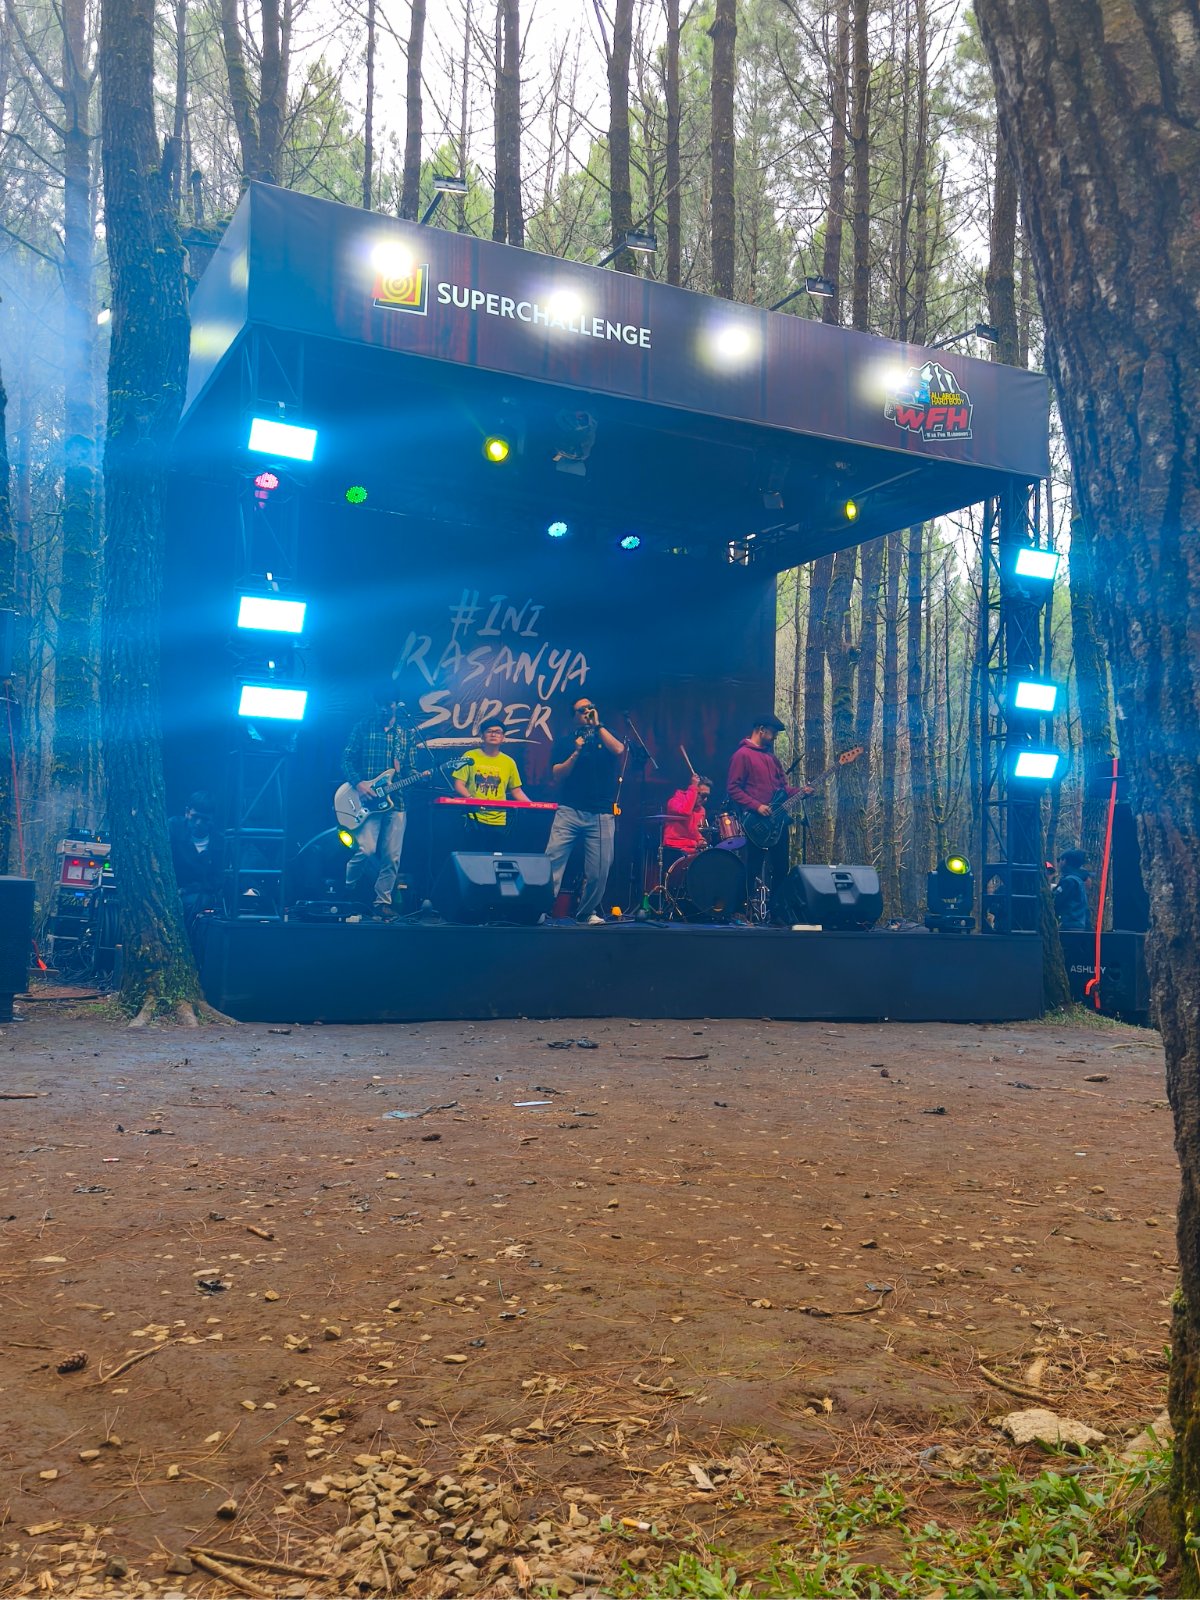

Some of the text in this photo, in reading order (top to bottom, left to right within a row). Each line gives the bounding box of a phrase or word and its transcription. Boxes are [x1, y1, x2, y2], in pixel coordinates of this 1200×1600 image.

[895, 404, 968, 431] WFH
[392, 631, 590, 700] RASANYA
[414, 690, 553, 741] SUPER
[1070, 965, 1106, 974] ASHLY
